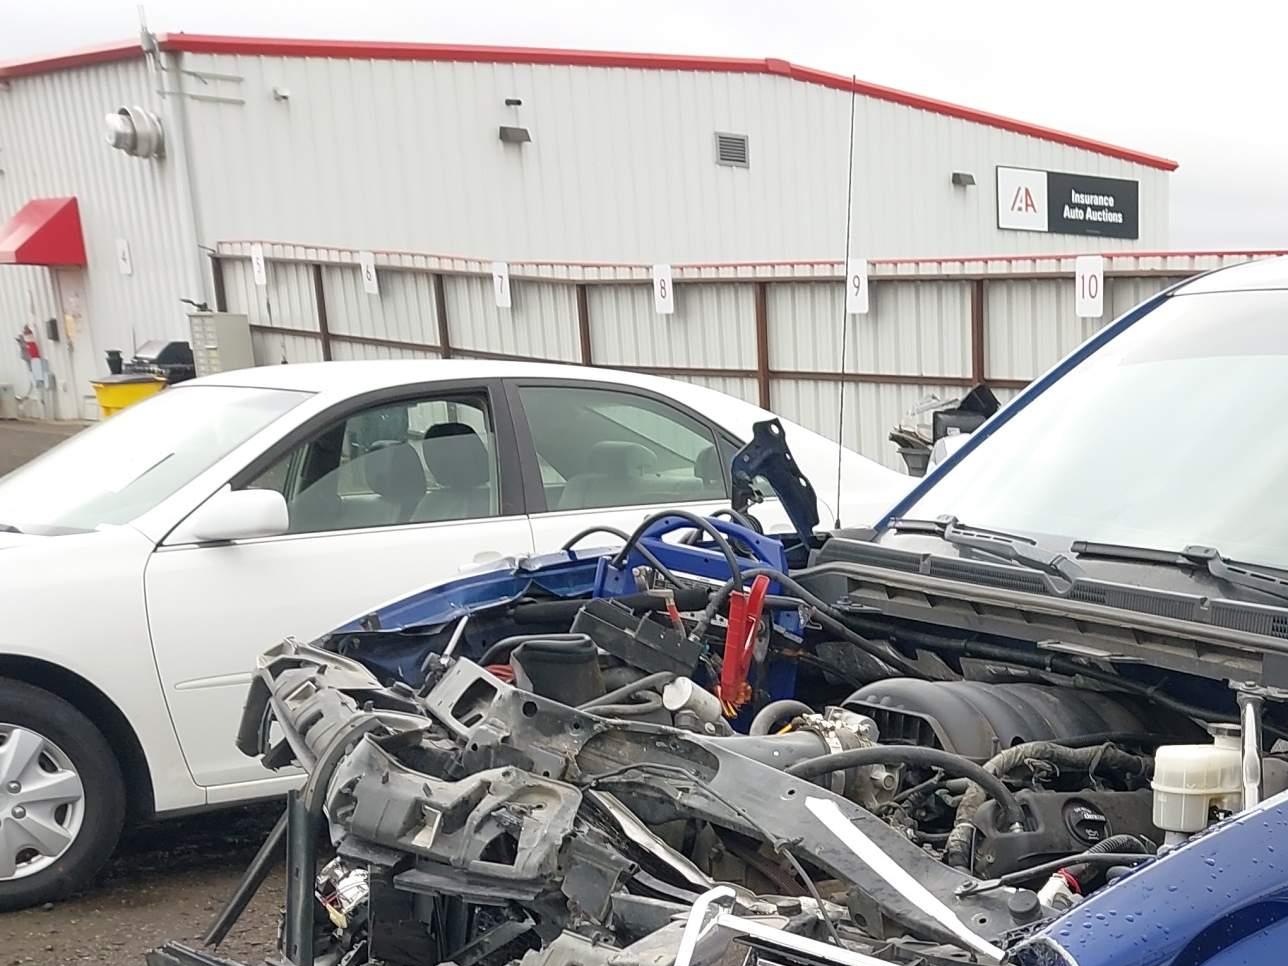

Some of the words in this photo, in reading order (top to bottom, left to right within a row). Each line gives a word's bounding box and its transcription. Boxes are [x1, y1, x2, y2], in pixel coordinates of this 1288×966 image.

[1071, 189, 1114, 207] Insurance
[1063, 204, 1084, 220] Auto
[1085, 207, 1123, 224] Auctions
[365, 264, 372, 281] 6
[497, 275, 504, 294] 7
[659, 278, 667, 299] 8
[852, 275, 861, 297] 9
[1081, 274, 1098, 299] 10
